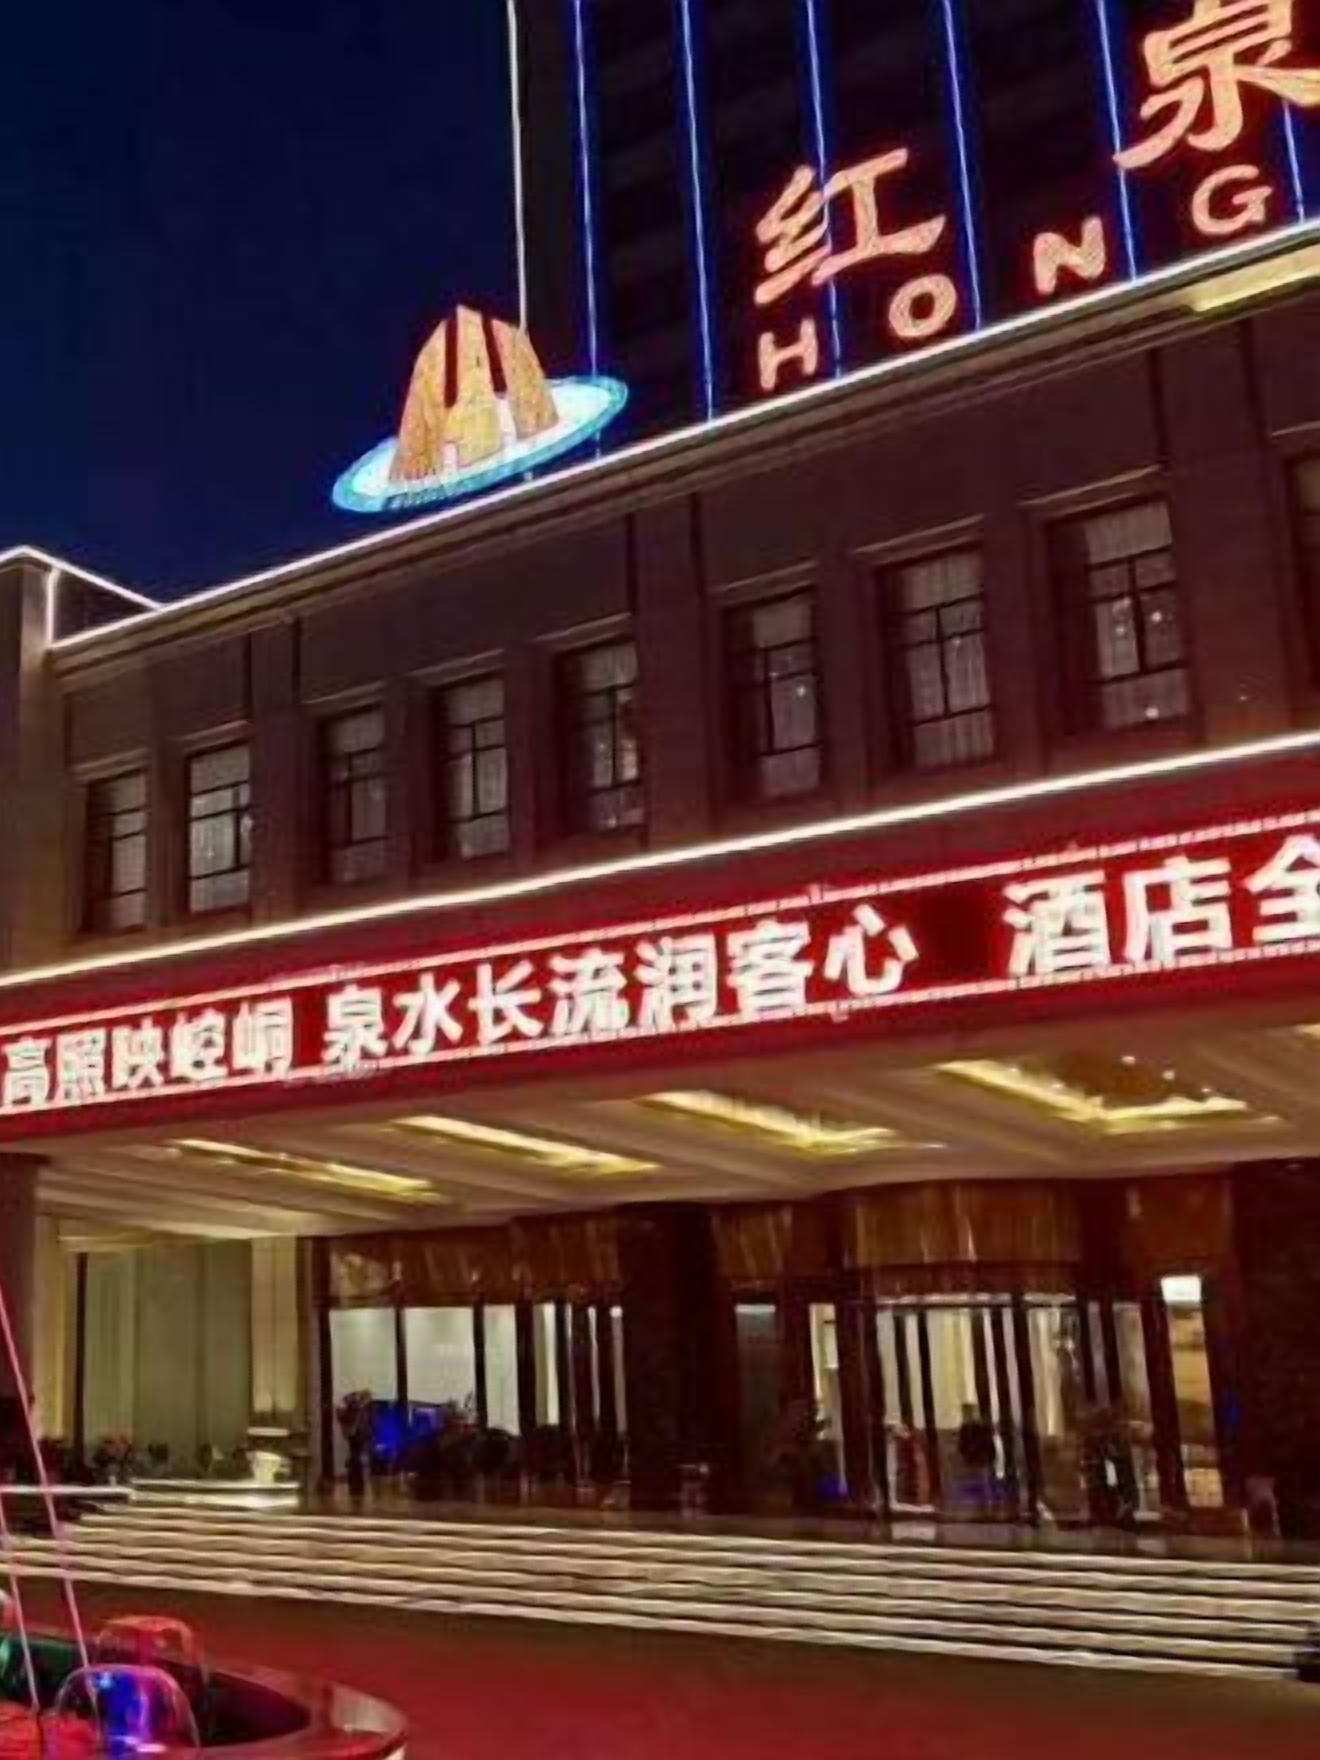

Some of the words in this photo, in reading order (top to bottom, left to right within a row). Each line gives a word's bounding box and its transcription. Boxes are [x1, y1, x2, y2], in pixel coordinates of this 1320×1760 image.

[754, 0, 1320, 305] 红泉
[758, 164, 1273, 390] HONG
[321, 903, 919, 1057] 泉水长流润客心
